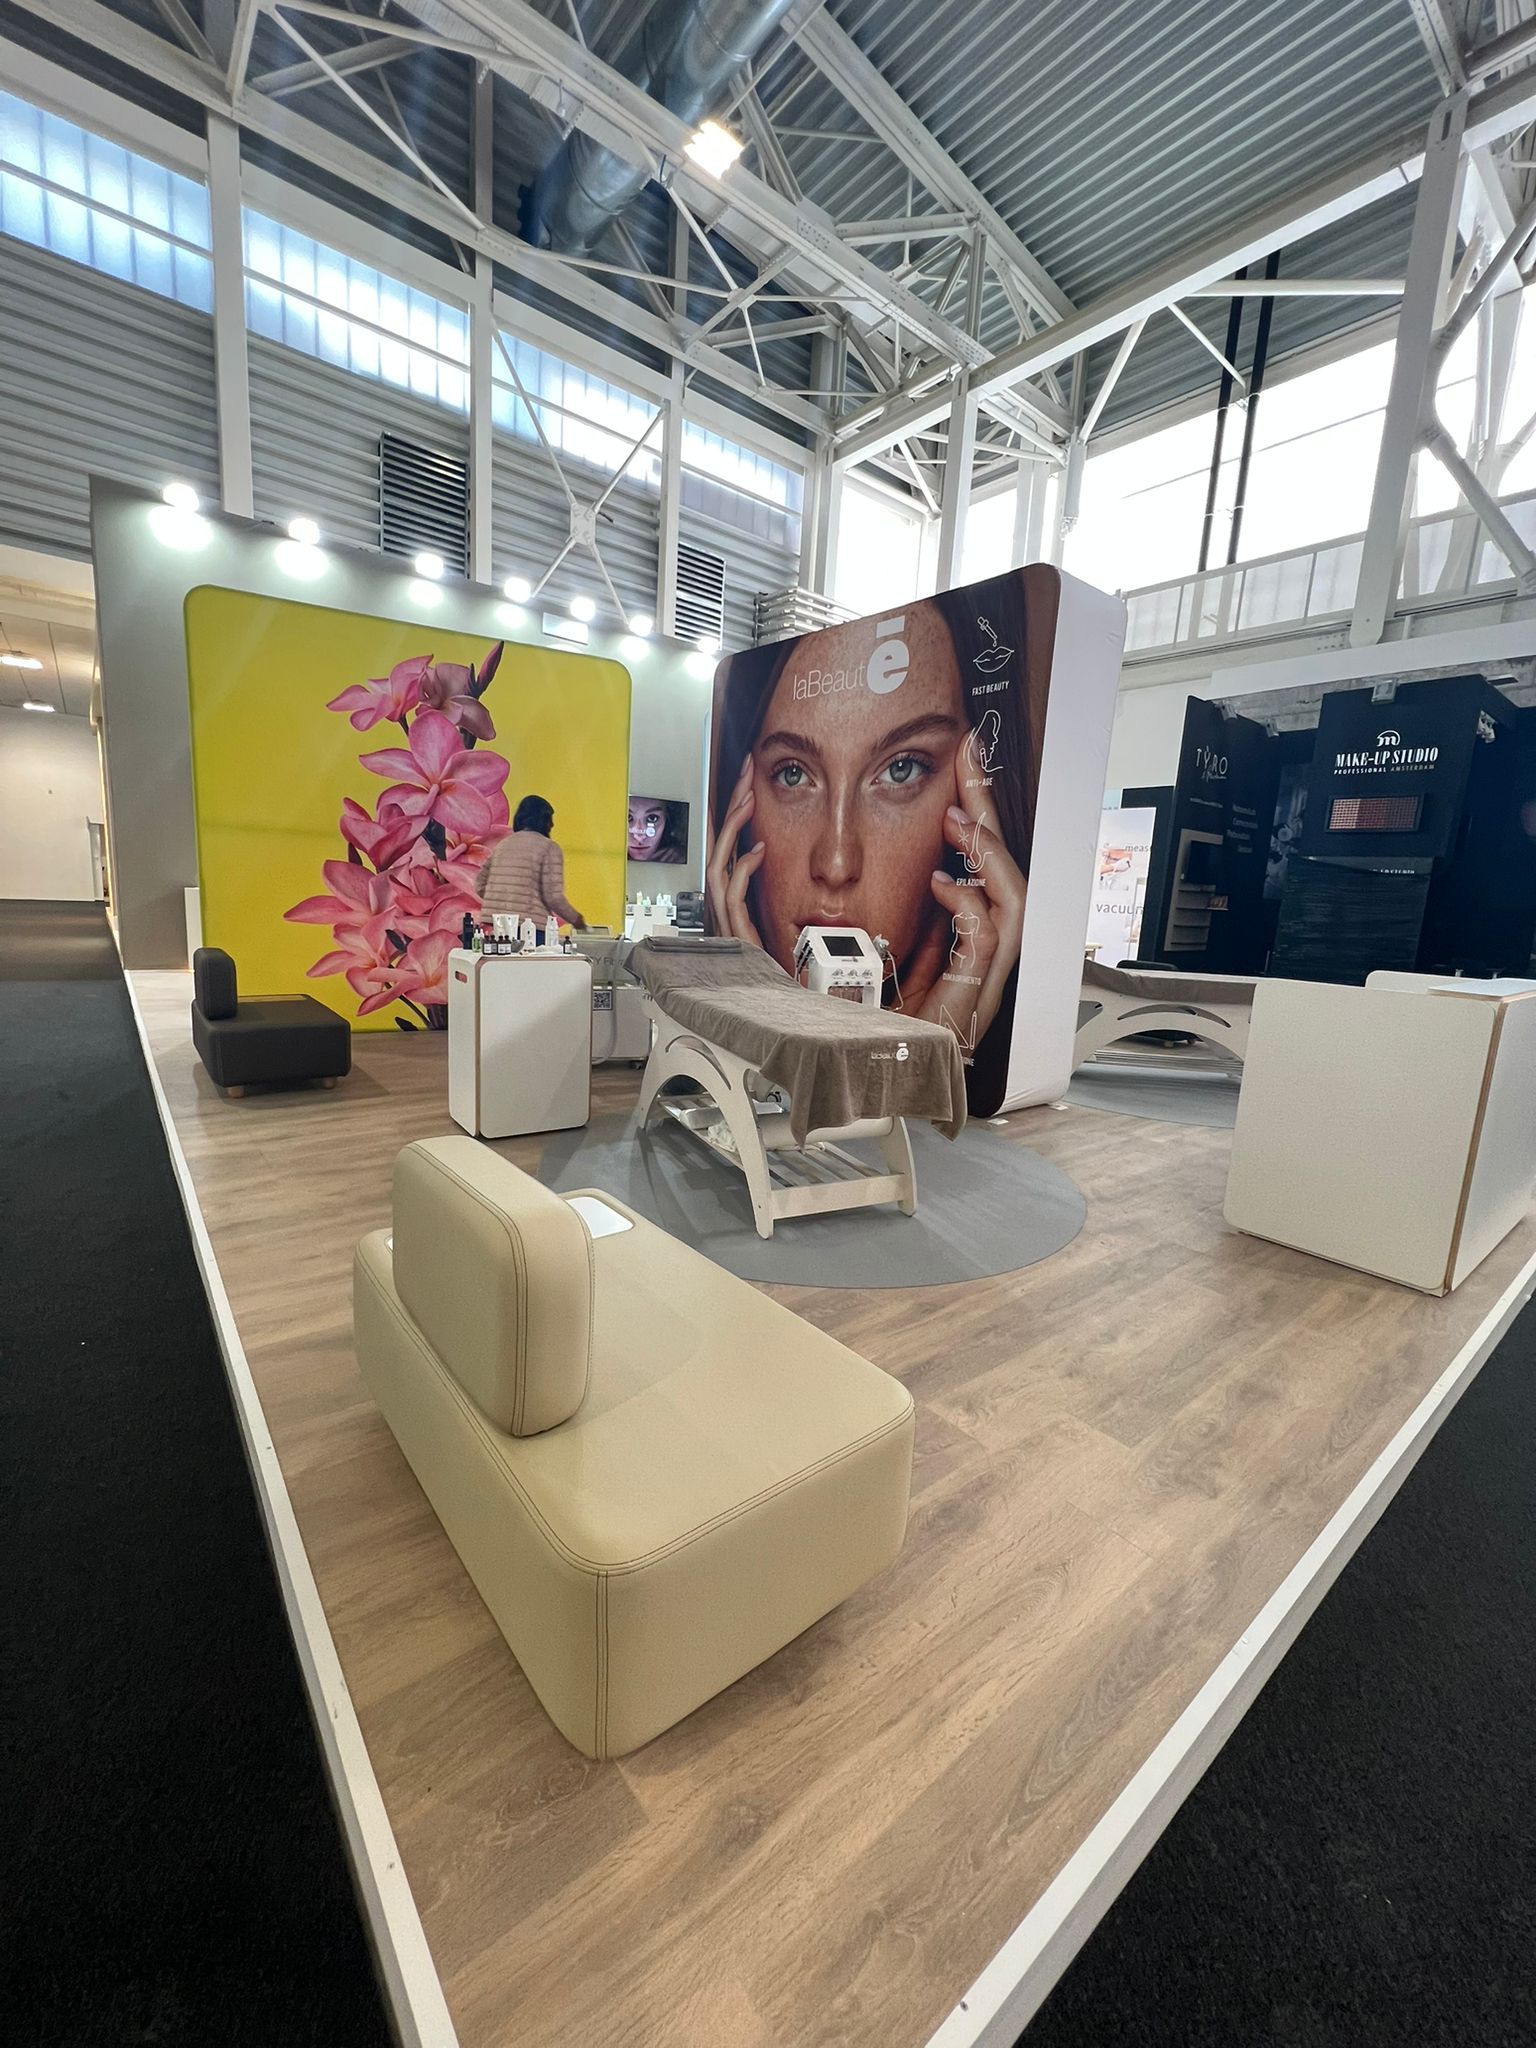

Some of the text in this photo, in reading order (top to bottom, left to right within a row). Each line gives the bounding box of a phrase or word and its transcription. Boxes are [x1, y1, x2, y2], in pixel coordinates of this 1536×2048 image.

[972, 680, 1010, 696] FAST BEAUTY
[1335, 747, 1439, 767] MAKE-UP STUDIO
[1333, 764, 1435, 775] PROFESSIONAL AMSTERDAM
[965, 777, 993, 788] ANTI-AGE
[956, 878, 986, 887] EPILAZIONE
